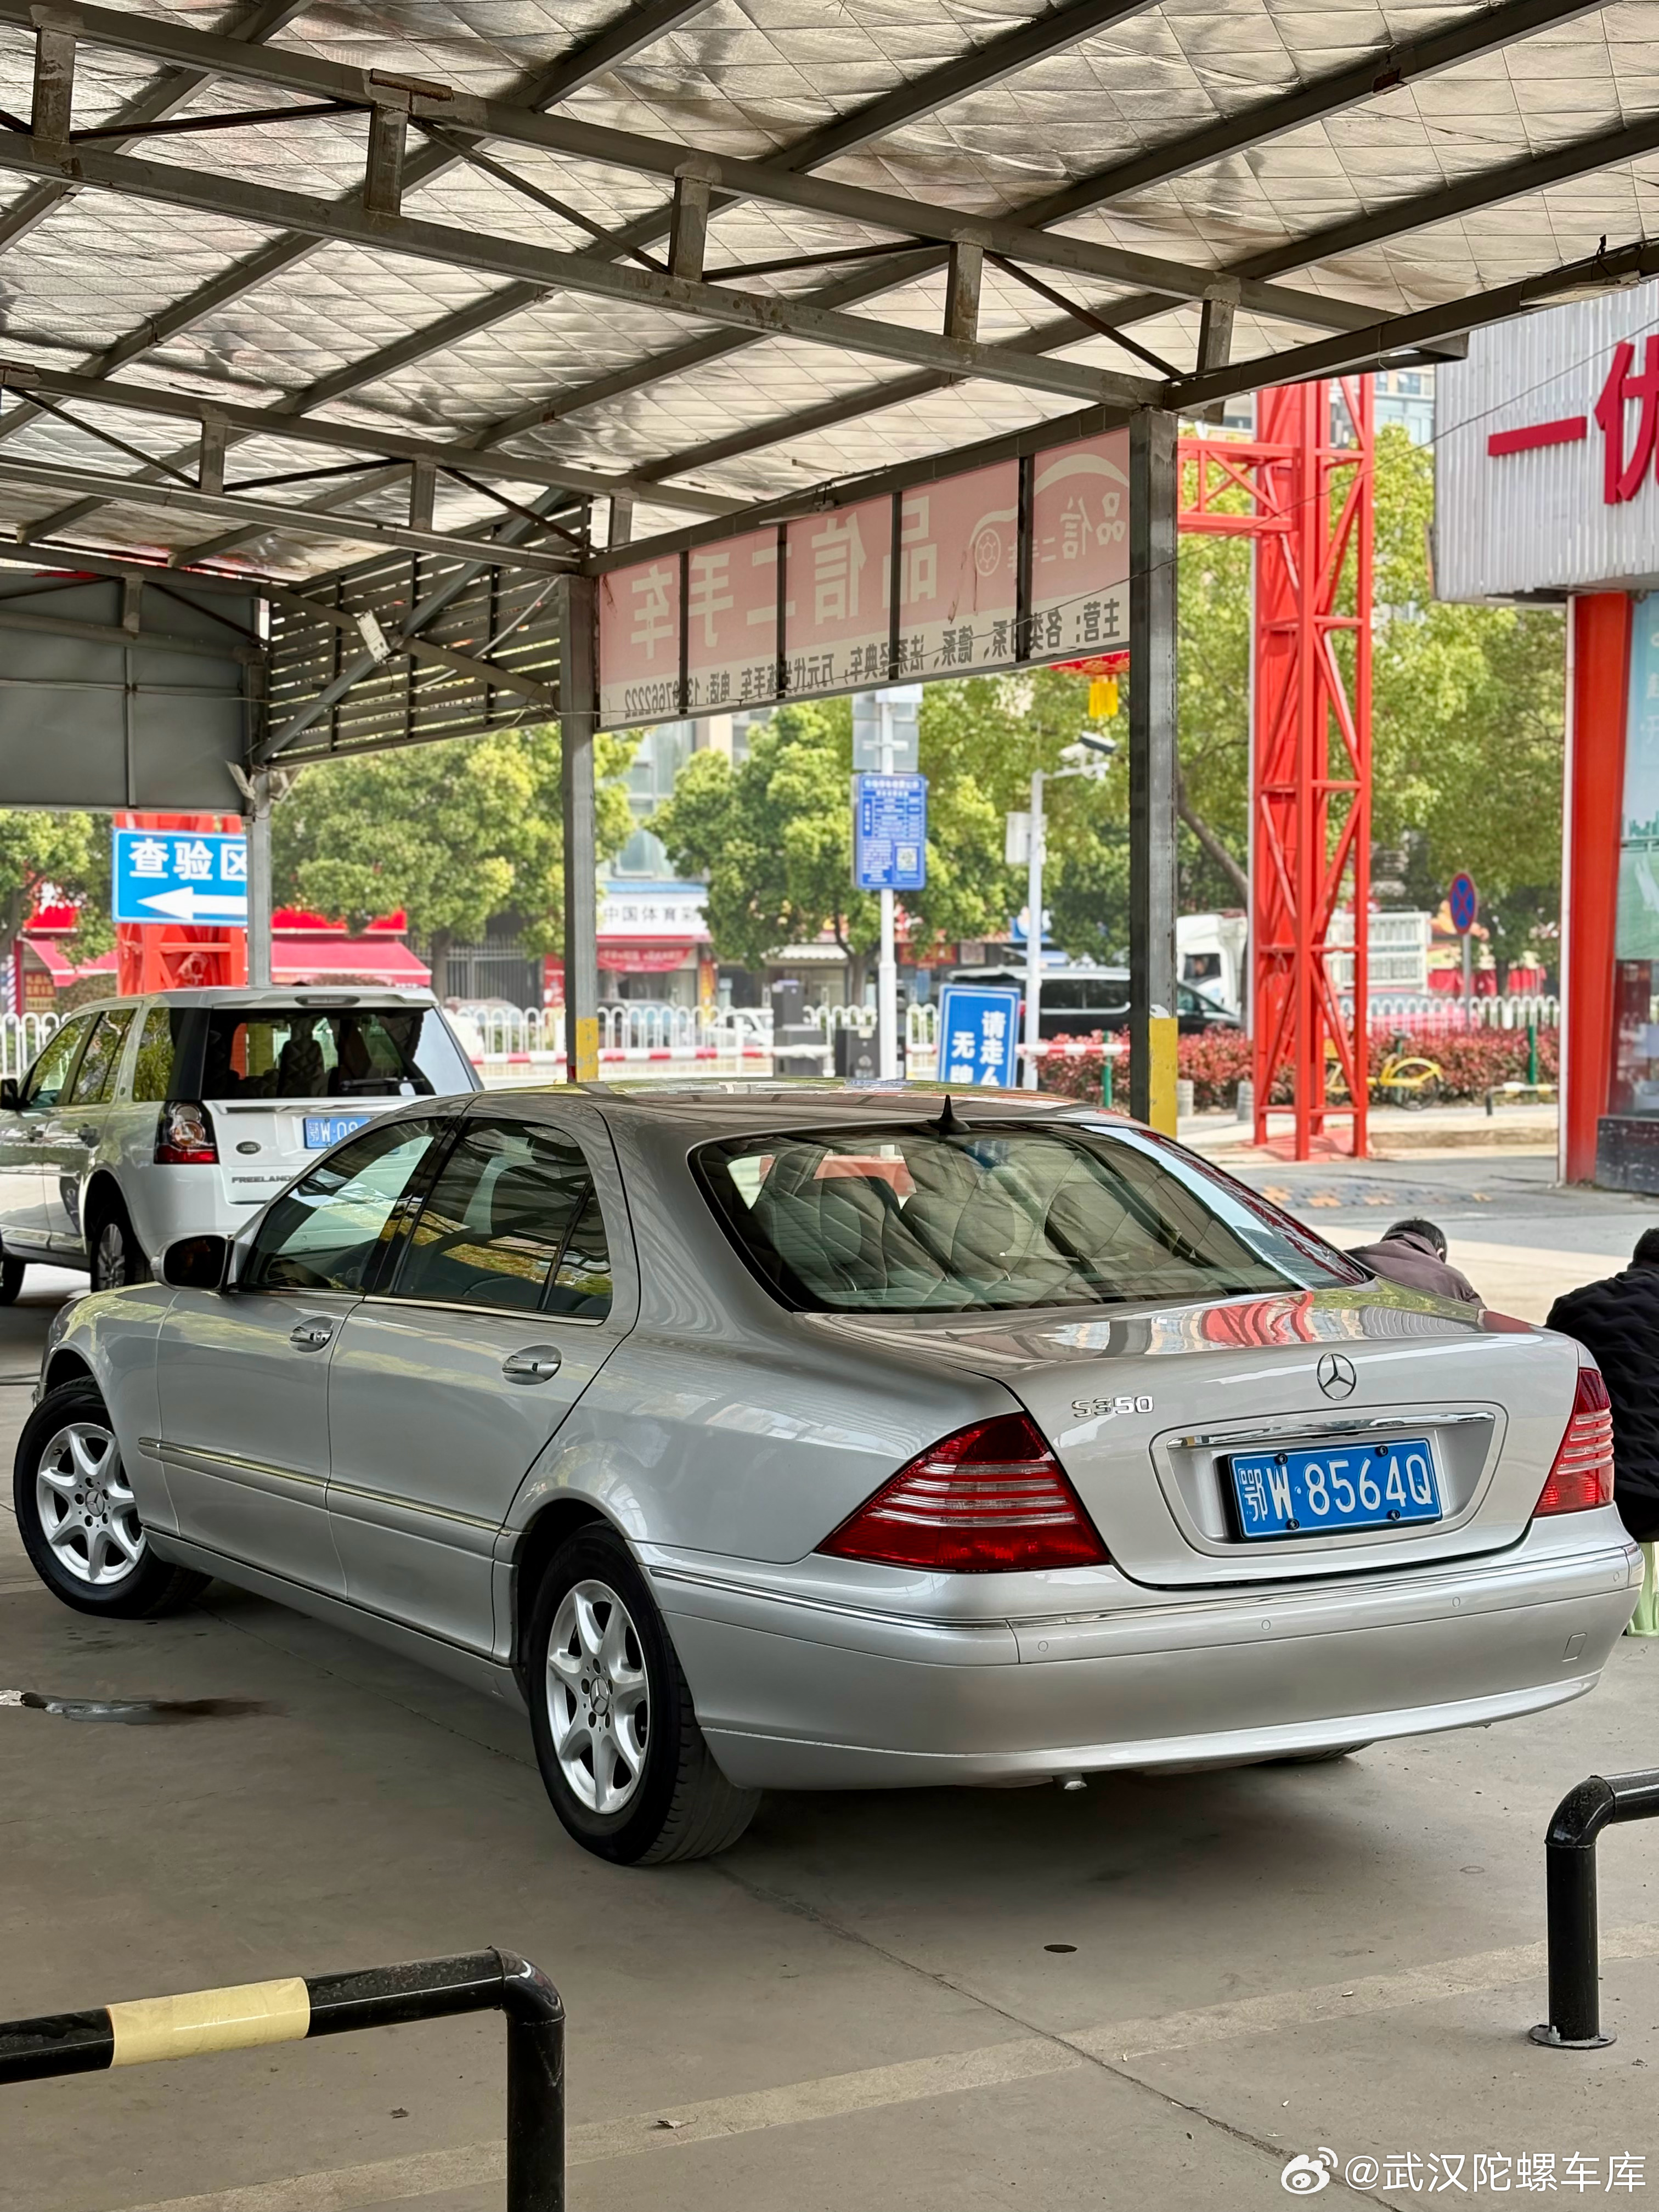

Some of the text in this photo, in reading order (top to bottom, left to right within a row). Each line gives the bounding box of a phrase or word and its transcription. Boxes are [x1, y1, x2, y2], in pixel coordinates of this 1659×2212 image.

[128, 838, 247, 881] 查验区
[1071, 1396, 1154, 1418] S350
[1238, 1454, 1433, 1522] 鄂W·8564Q
